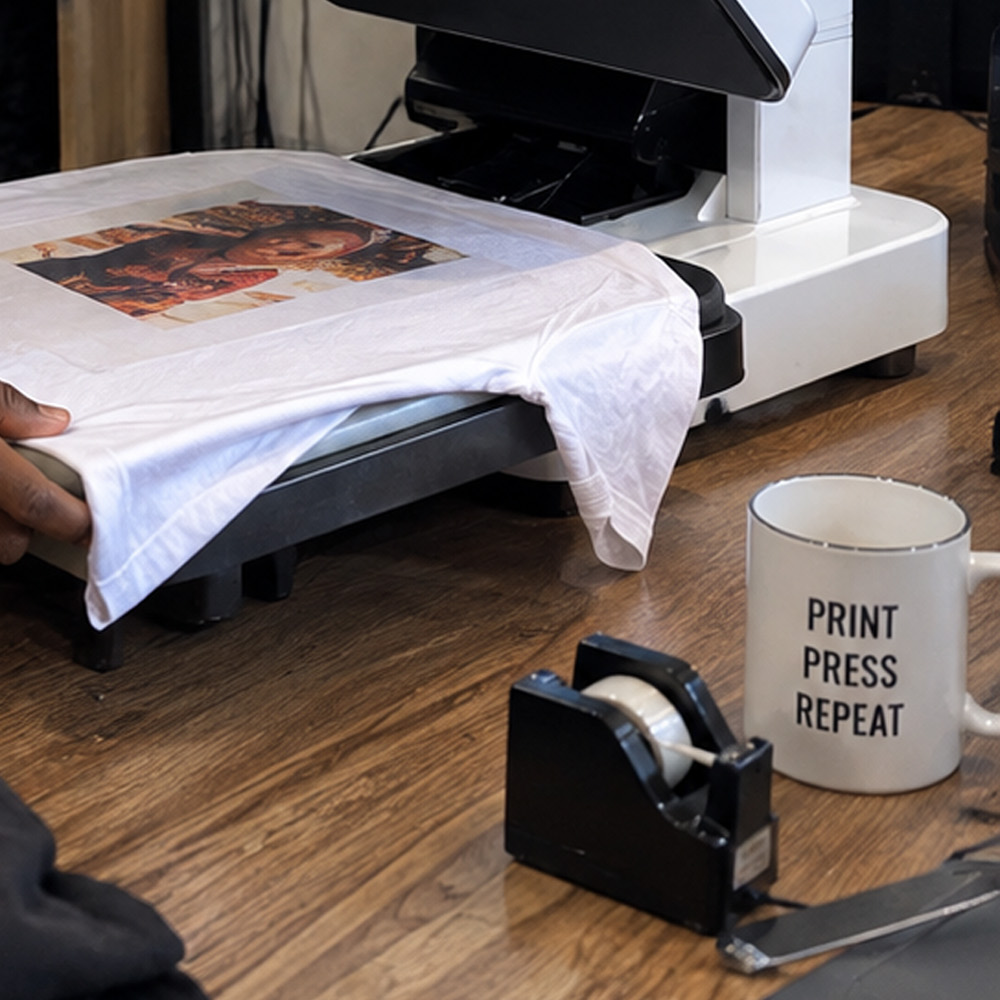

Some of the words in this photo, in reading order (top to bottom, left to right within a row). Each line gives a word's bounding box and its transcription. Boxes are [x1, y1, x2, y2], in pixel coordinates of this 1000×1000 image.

[807, 597, 899, 640] PRINT
[803, 645, 898, 689] PRESS
[795, 691, 905, 738] REPEAT
